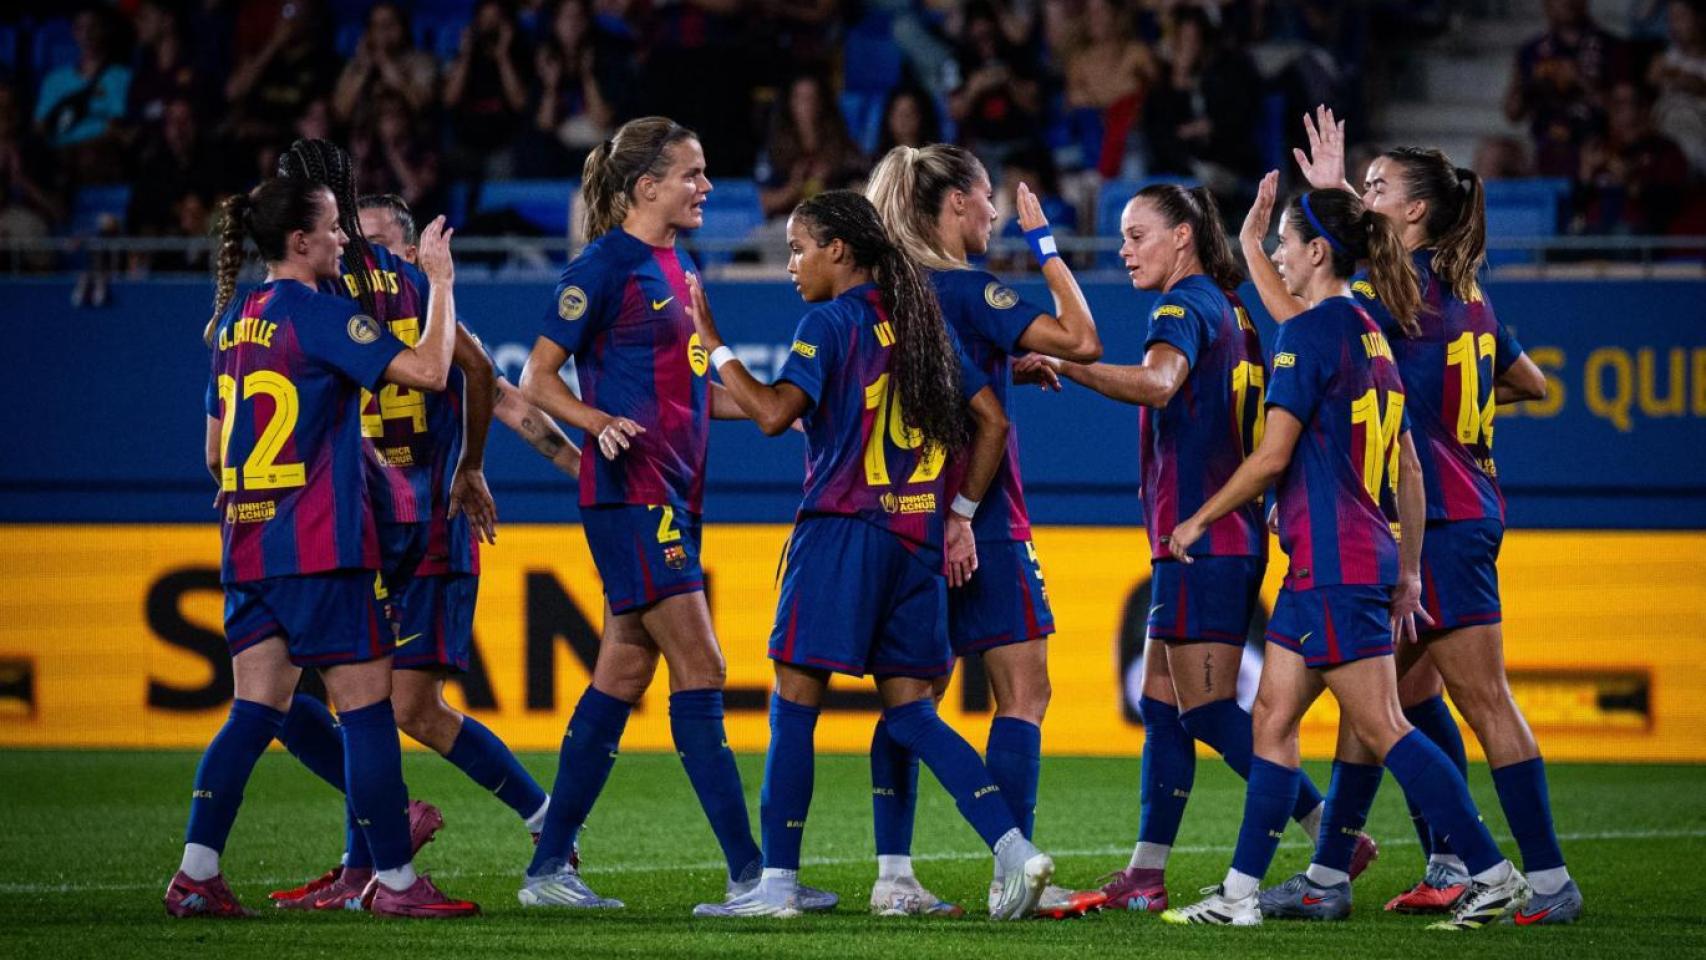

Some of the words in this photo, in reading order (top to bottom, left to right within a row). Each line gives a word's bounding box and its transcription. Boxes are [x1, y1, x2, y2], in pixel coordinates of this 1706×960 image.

[1447, 331, 1497, 449] 12
[218, 370, 307, 492] 22
[1351, 388, 1405, 506] 14
[238, 501, 275, 512] UNHCR
[899, 493, 935, 504] UNHCR
[900, 502, 936, 511] ACNUR
[239, 508, 275, 520] ACNUR
[648, 504, 681, 543] 2
